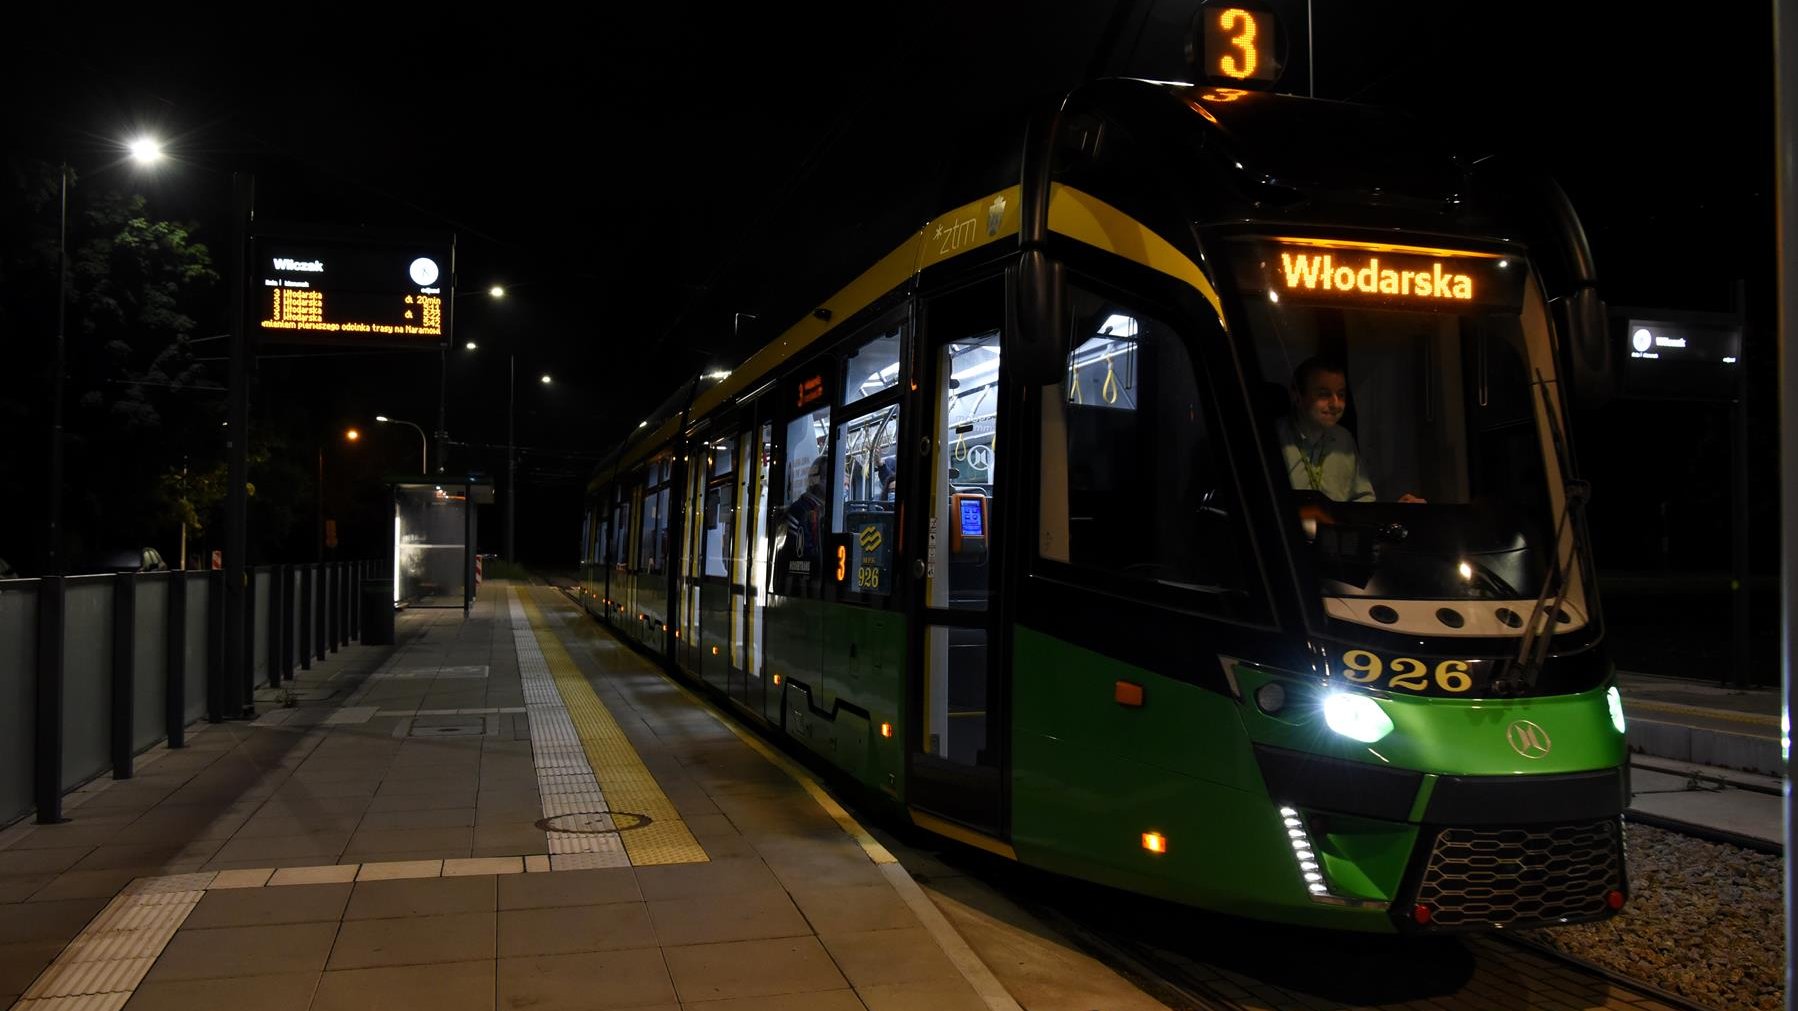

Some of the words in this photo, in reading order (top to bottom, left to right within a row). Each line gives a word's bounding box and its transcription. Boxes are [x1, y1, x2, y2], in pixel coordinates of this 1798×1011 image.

[1220, 8, 1257, 79] 3
[1281, 252, 1473, 299] Włodarska
[835, 544, 847, 582] 3
[858, 567, 880, 588] 926
[1341, 648, 1473, 693] 926
